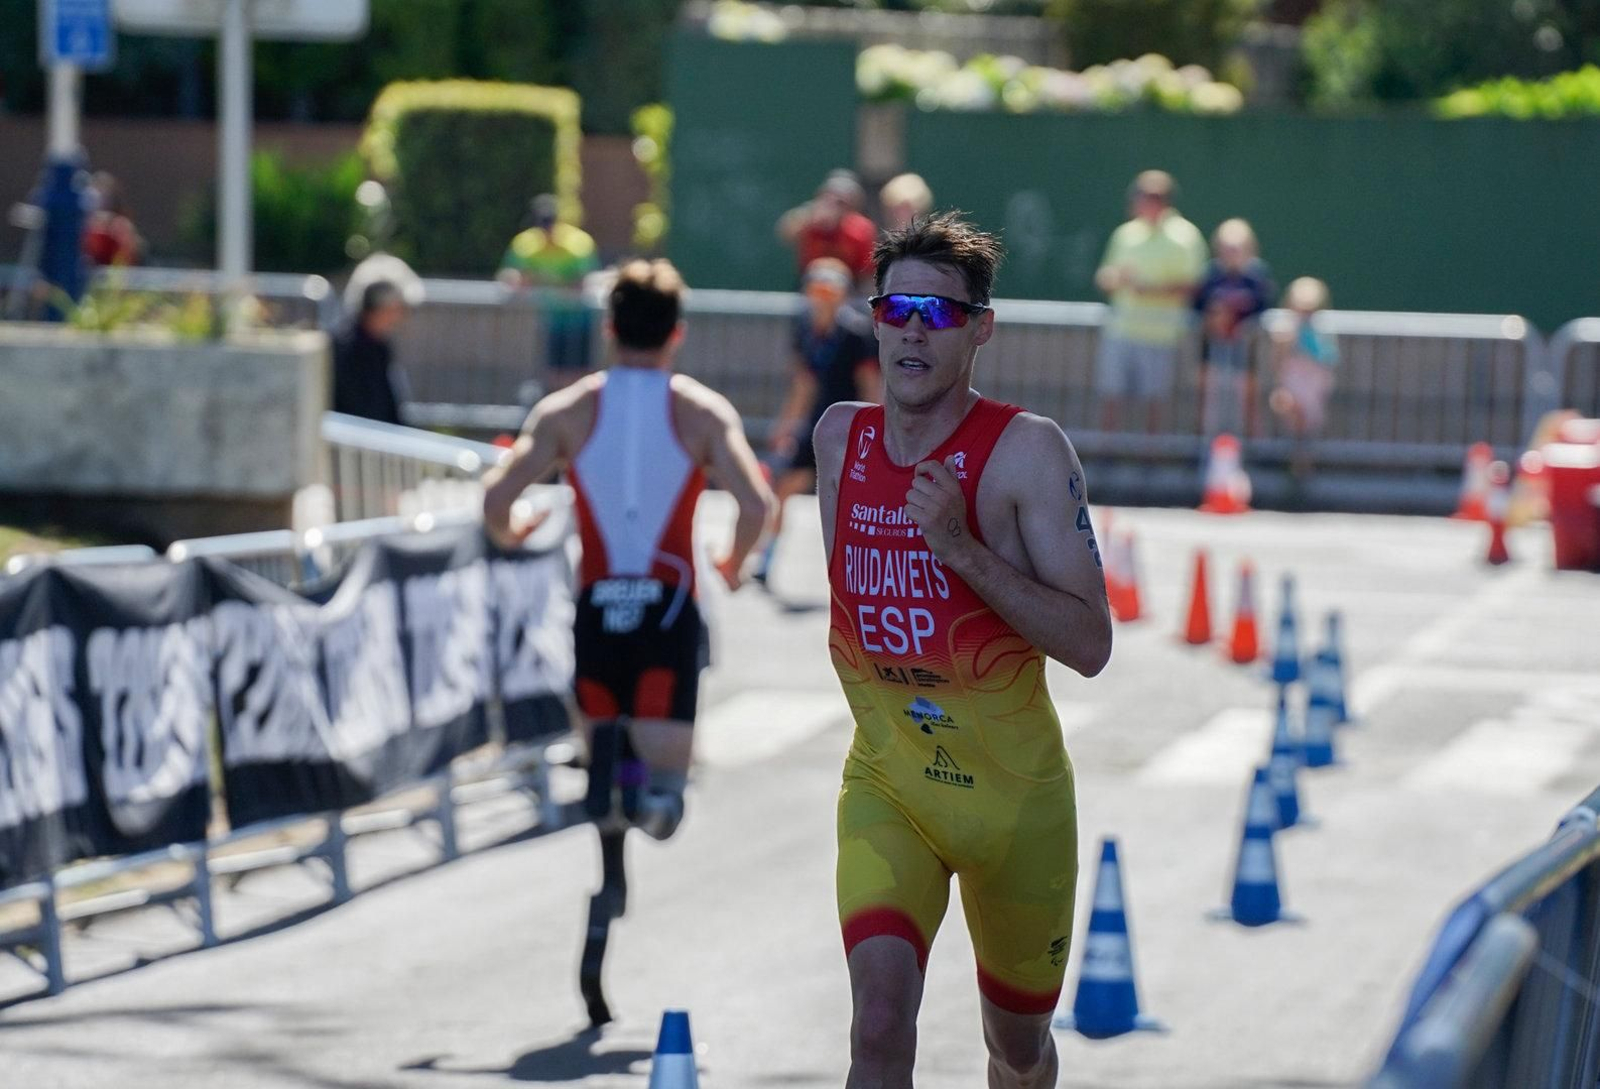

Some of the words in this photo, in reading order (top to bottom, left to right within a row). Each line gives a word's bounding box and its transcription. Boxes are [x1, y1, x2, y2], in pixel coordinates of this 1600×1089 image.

[876, 526, 907, 538] SEGUROS
[845, 544, 950, 600] RIUDAVETS
[858, 604, 936, 655] ESP
[903, 709, 955, 724] MENORCA
[924, 767, 974, 785] ARTIEM
